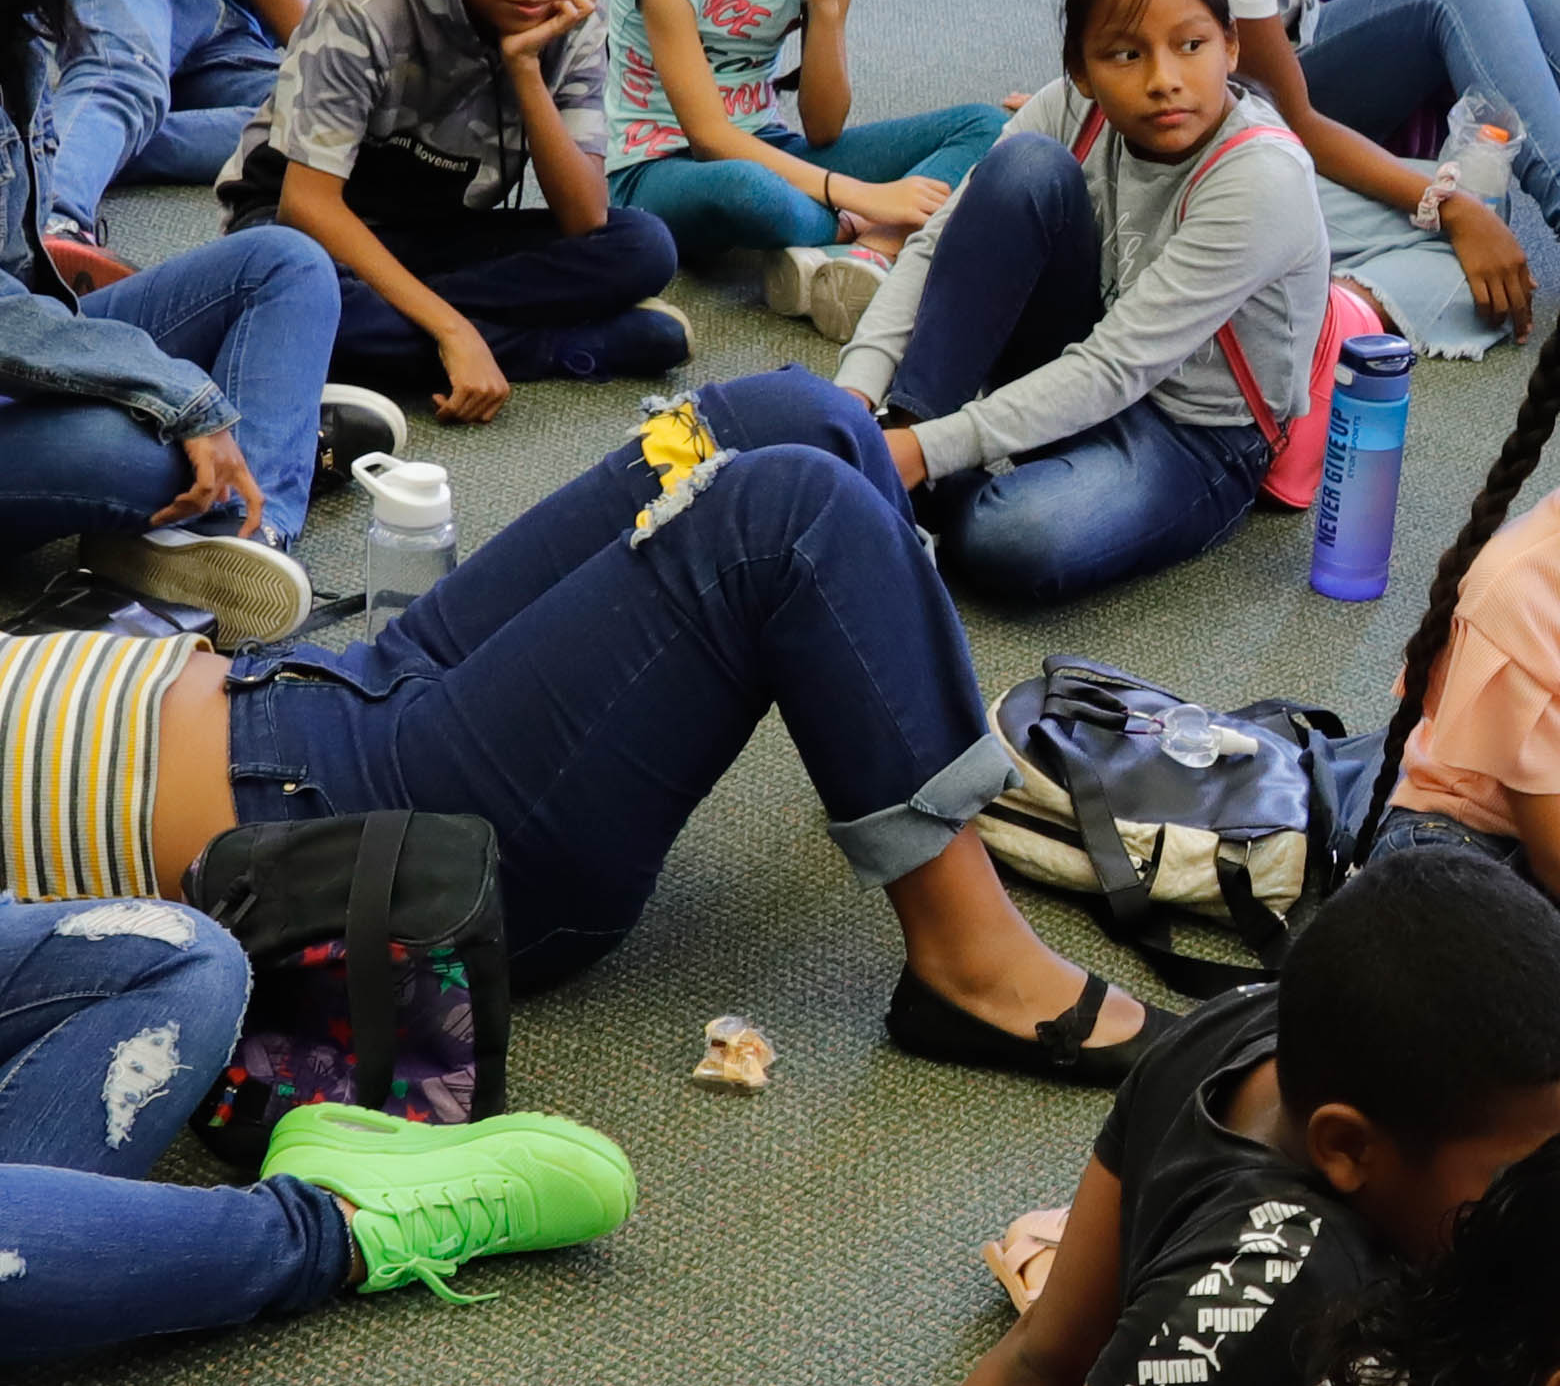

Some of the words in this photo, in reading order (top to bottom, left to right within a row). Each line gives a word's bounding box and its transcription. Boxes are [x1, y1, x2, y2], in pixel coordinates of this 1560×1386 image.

[415, 144, 469, 173] Movement
[1333, 409, 1350, 438] UP
[1325, 441, 1347, 485] GIVE
[1318, 488, 1341, 547] NEVER
[1138, 1358, 1208, 1385] PUMA
